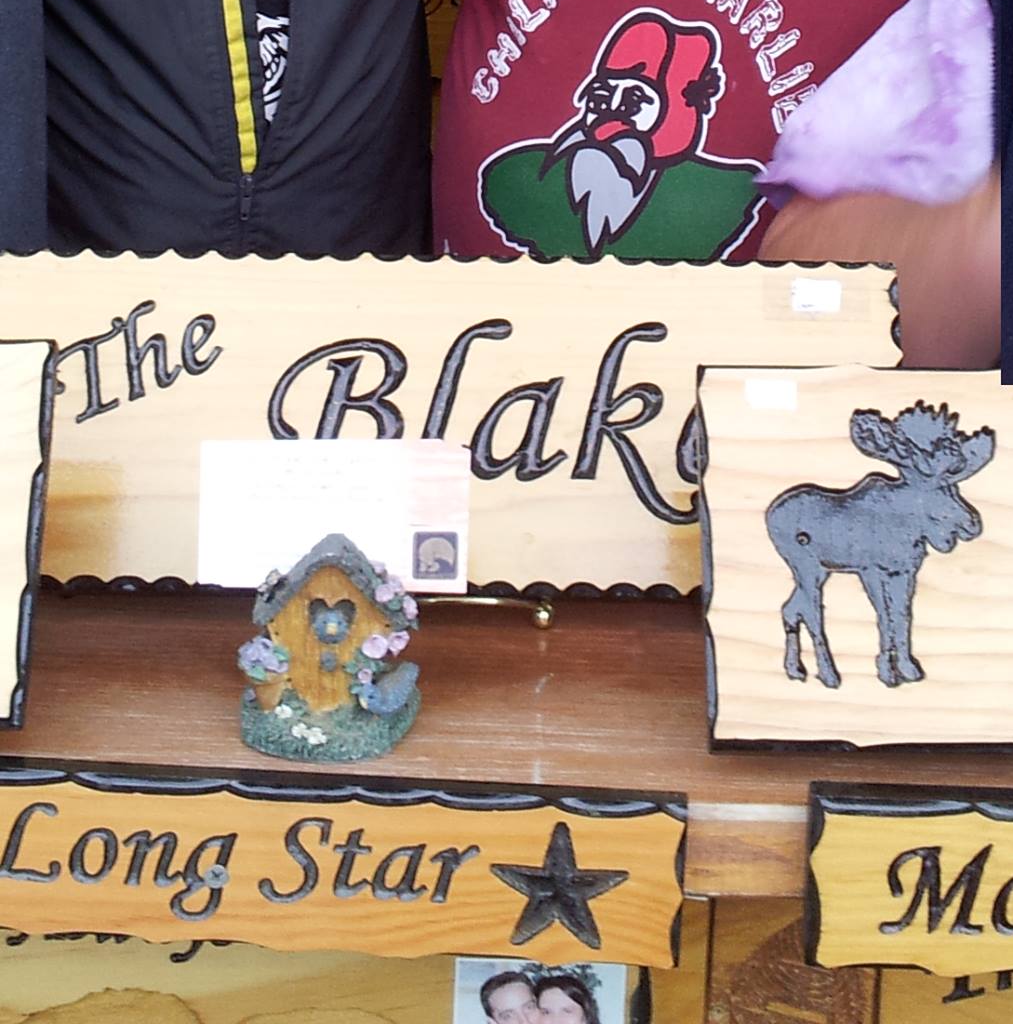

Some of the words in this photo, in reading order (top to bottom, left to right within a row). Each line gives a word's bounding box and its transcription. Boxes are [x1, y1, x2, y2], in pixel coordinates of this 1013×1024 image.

[54, 299, 223, 423] The
[0, 801, 238, 922] Long
[257, 816, 480, 904] Star
